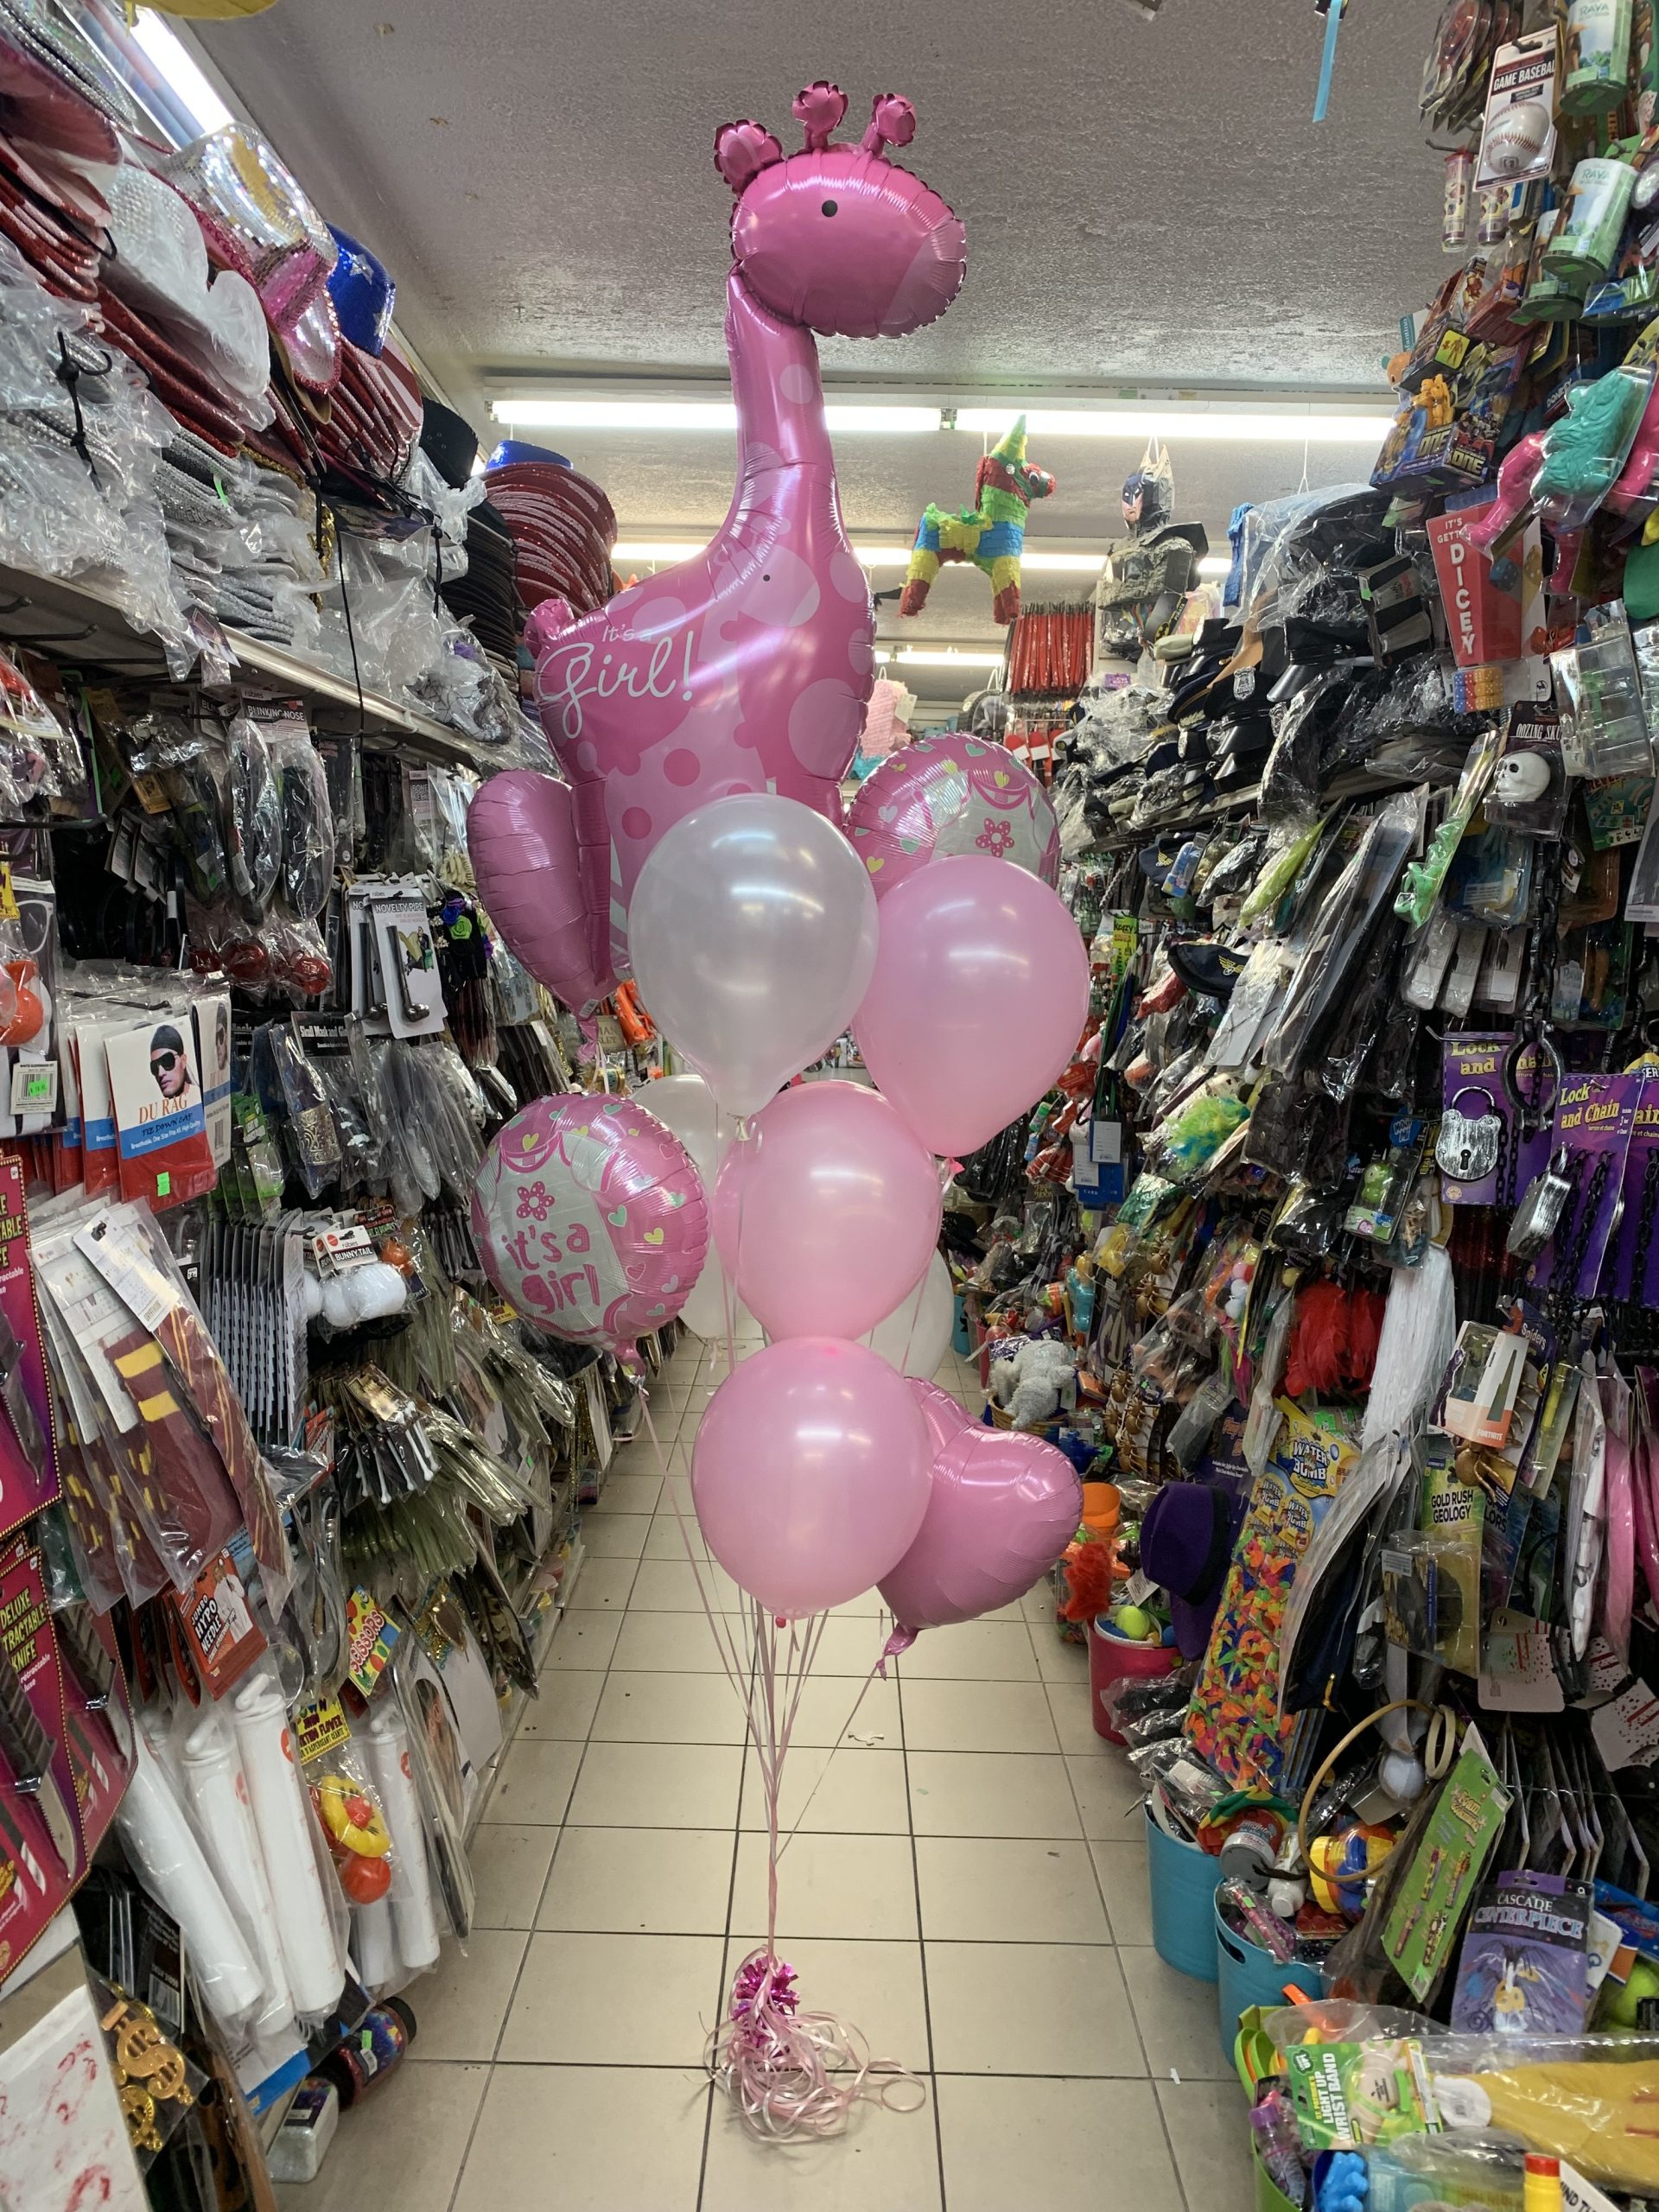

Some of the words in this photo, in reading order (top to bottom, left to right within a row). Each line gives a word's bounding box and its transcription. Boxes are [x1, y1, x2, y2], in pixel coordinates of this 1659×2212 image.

[1494, 73, 1516, 91] GAME
[1519, 60, 1555, 84] BASEBAL
[1451, 448, 1486, 474] ONE
[1445, 517, 1463, 531] IT'S
[1450, 543, 1476, 656] DICEY
[602, 624, 636, 642] It's
[283, 711, 306, 721] NOSE
[1516, 723, 1543, 739] OOZING
[1545, 724, 1561, 741] SKU
[375, 903, 409, 914] NOVELTY
[409, 901, 425, 912] PIPE
[1459, 1057, 1497, 1076] and
[138, 1102, 158, 1125] DU
[162, 1092, 188, 1115] RAG
[1559, 1083, 1591, 1107] Lock
[156, 1118, 179, 1135] DOWN
[1560, 1107, 1581, 1129] and
[1585, 1098, 1620, 1124] Chain
[334, 1250, 358, 1262] BUNNY
[359, 1247, 373, 1257] TAIL
[501, 1224, 562, 1270] it's
[566, 1223, 590, 1253] a
[522, 1264, 601, 1314] girl
[1521, 1322, 1547, 1351] Spiders
[1293, 1440, 1329, 1466] WATER
[1293, 1457, 1327, 1481] BOMB
[1431, 1493, 1451, 1508] GOLD
[1452, 1489, 1473, 1505] RUSH
[1433, 1504, 1471, 1523] GEOLOGY
[0, 1587, 32, 1630] DELUXE
[192, 1594, 208, 1625] JUMBO
[194, 1599, 217, 1639] HYPO
[2, 1602, 47, 1653] TRACTABLE
[200, 1614, 222, 1655] NEEDLE
[10, 1638, 37, 1673] KNIFE
[350, 1609, 385, 1677] SCISSORS
[1497, 1893, 1554, 1912] CASCADE
[1474, 1905, 1585, 1940] CENTERPIECE
[1314, 2070, 1327, 2088] UP
[1322, 2052, 1342, 2093] BAND
[1320, 2090, 1335, 2125] LIGHT
[1330, 2094, 1351, 2140] WRIST
